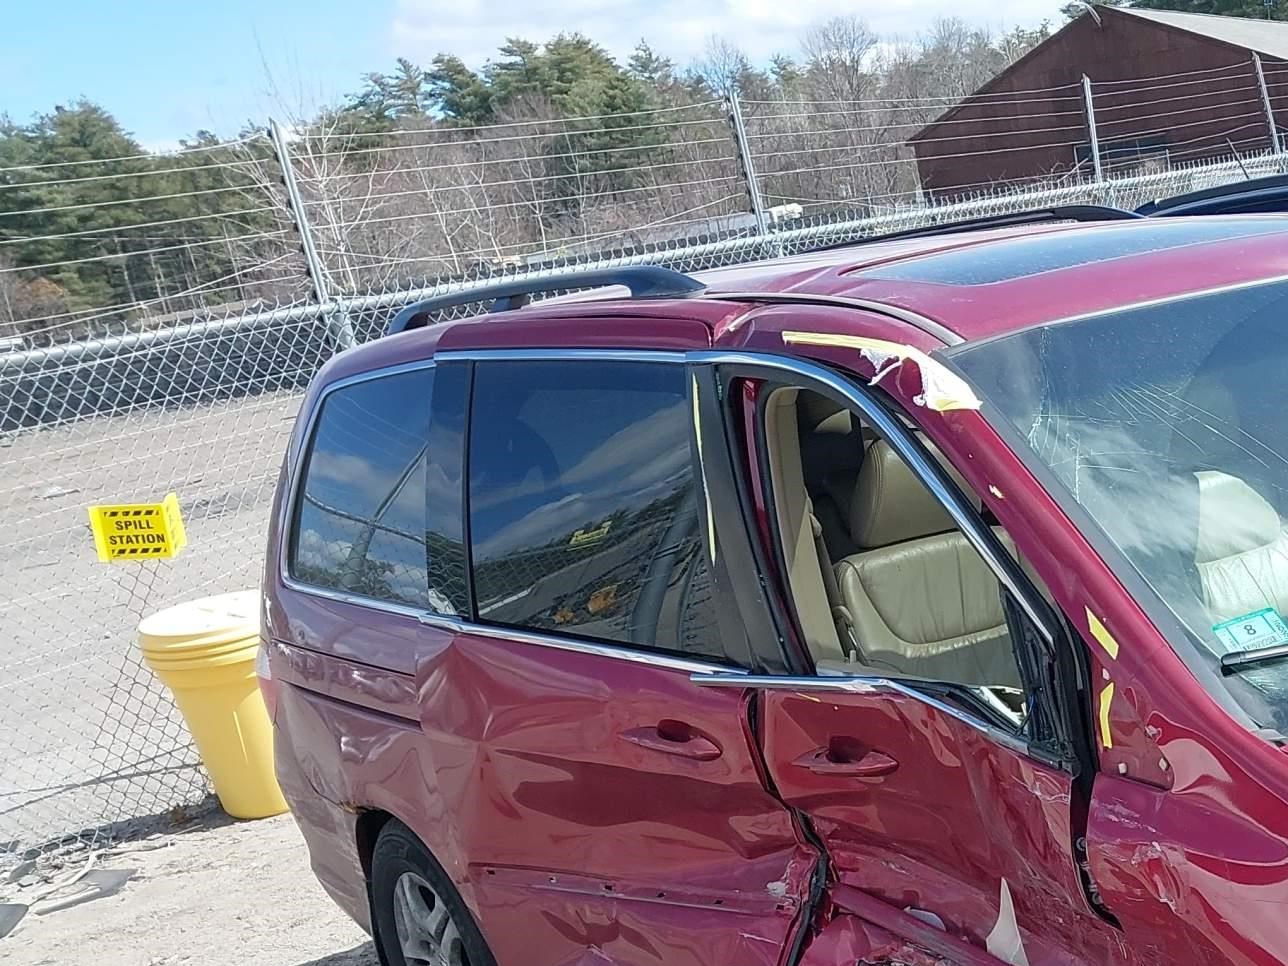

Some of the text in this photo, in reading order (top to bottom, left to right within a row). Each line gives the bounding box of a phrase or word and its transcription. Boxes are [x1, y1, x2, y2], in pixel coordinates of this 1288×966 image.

[115, 519, 154, 531] SPILL
[109, 533, 166, 545] STATION
[1243, 624, 1257, 636] 8
